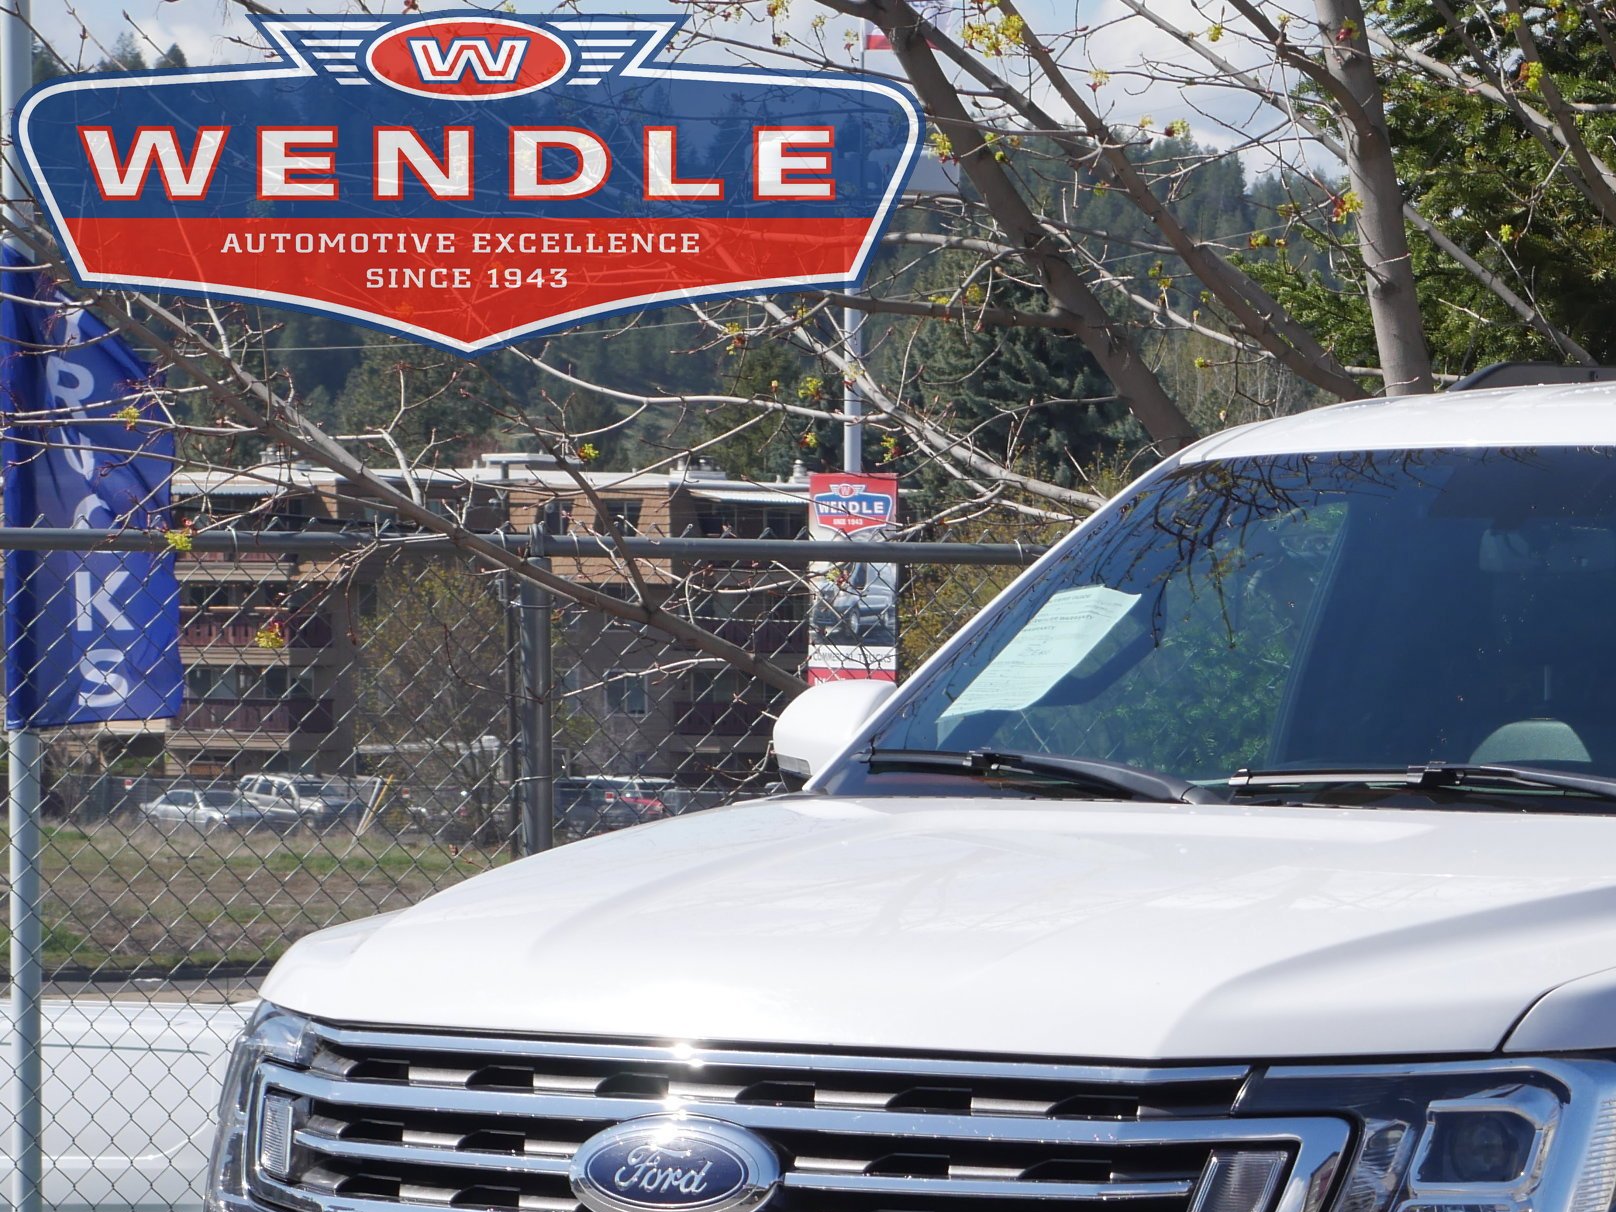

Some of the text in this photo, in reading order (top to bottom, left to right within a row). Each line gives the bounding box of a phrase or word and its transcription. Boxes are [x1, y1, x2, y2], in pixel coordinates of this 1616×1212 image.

[817, 500, 885, 514] WENDLE
[847, 518, 864, 526] 1943
[614, 1144, 713, 1196] Ford
